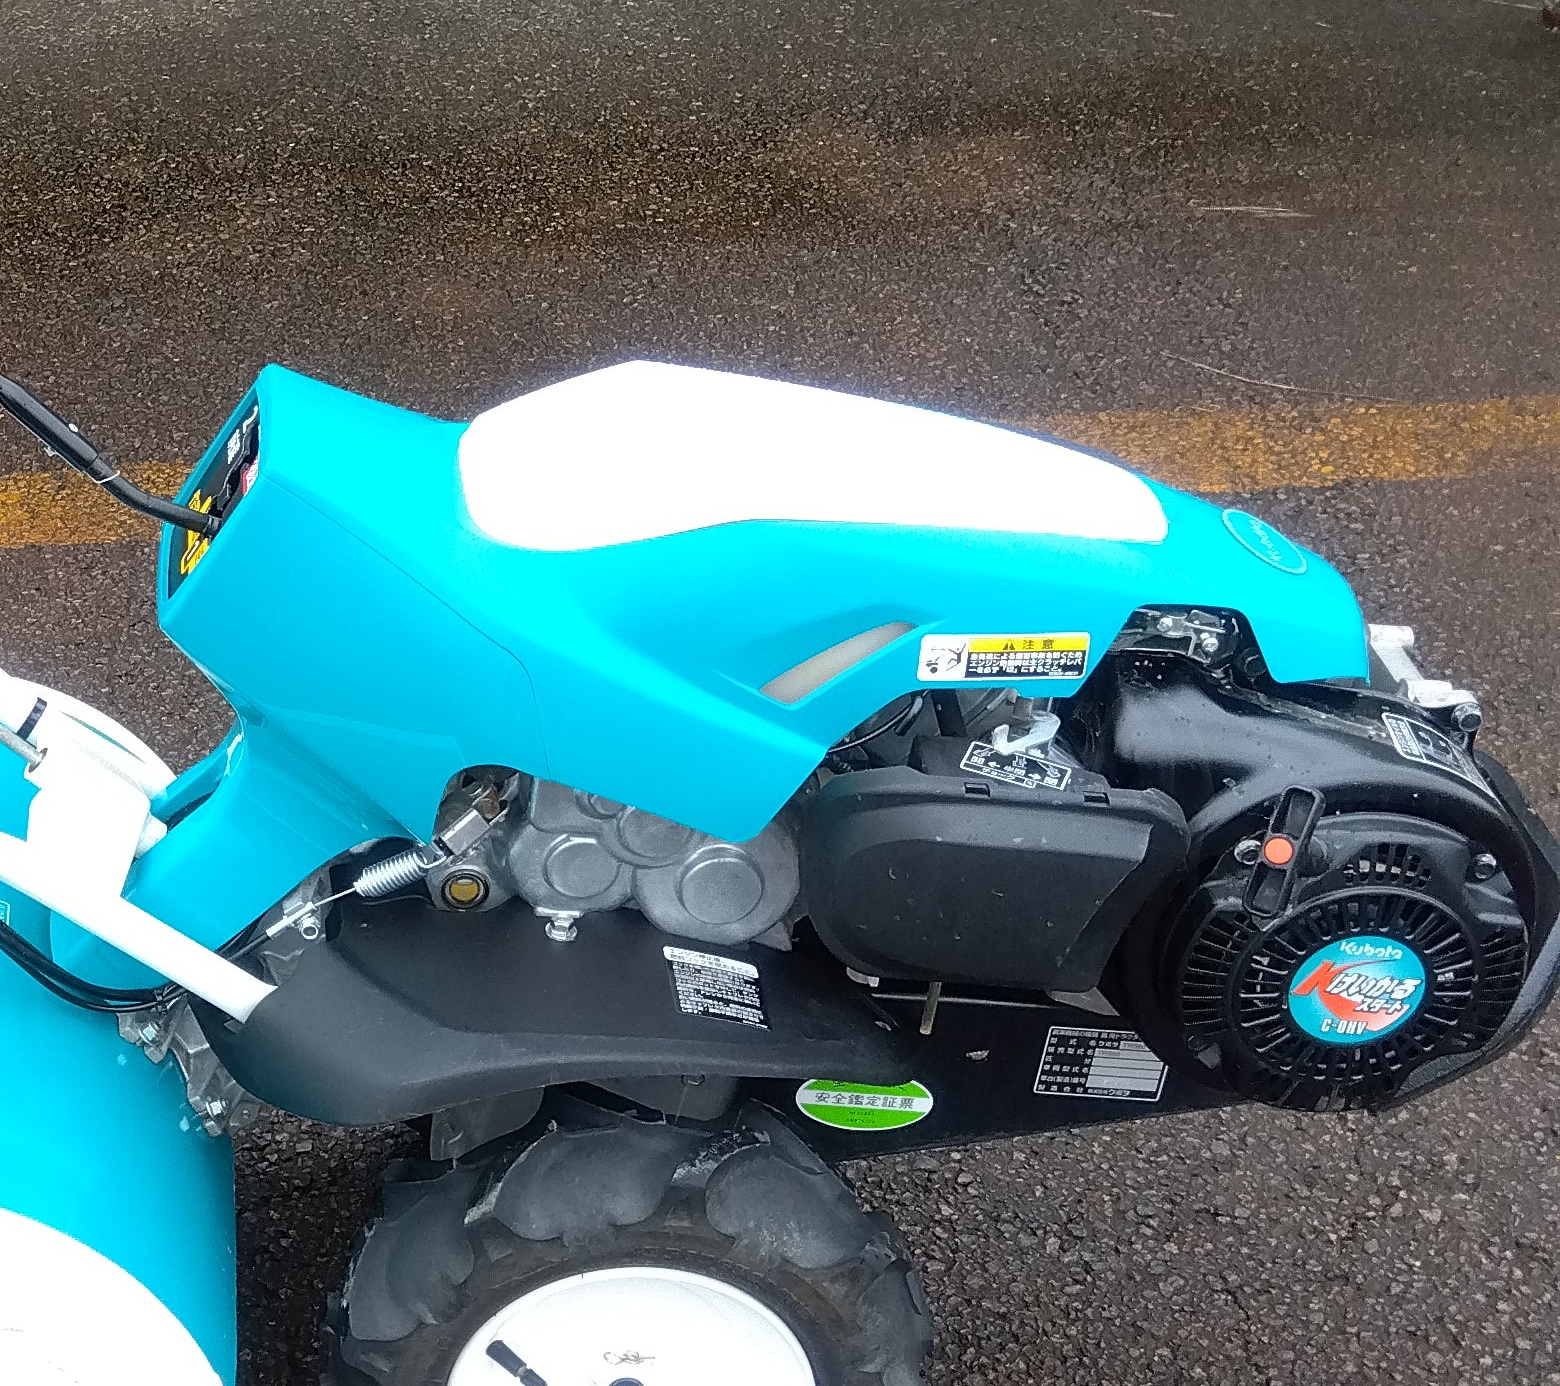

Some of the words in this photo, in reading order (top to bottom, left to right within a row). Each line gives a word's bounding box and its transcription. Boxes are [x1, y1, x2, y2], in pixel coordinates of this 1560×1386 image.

[1023, 639, 1054, 650] 注意
[1340, 941, 1403, 959] Kubota
[1325, 973, 1422, 1000] けいかる
[1354, 997, 1403, 1015] スタート
[1321, 1018, 1367, 1035] C-OHV
[814, 1092, 915, 1110] 安全鑑定証票
